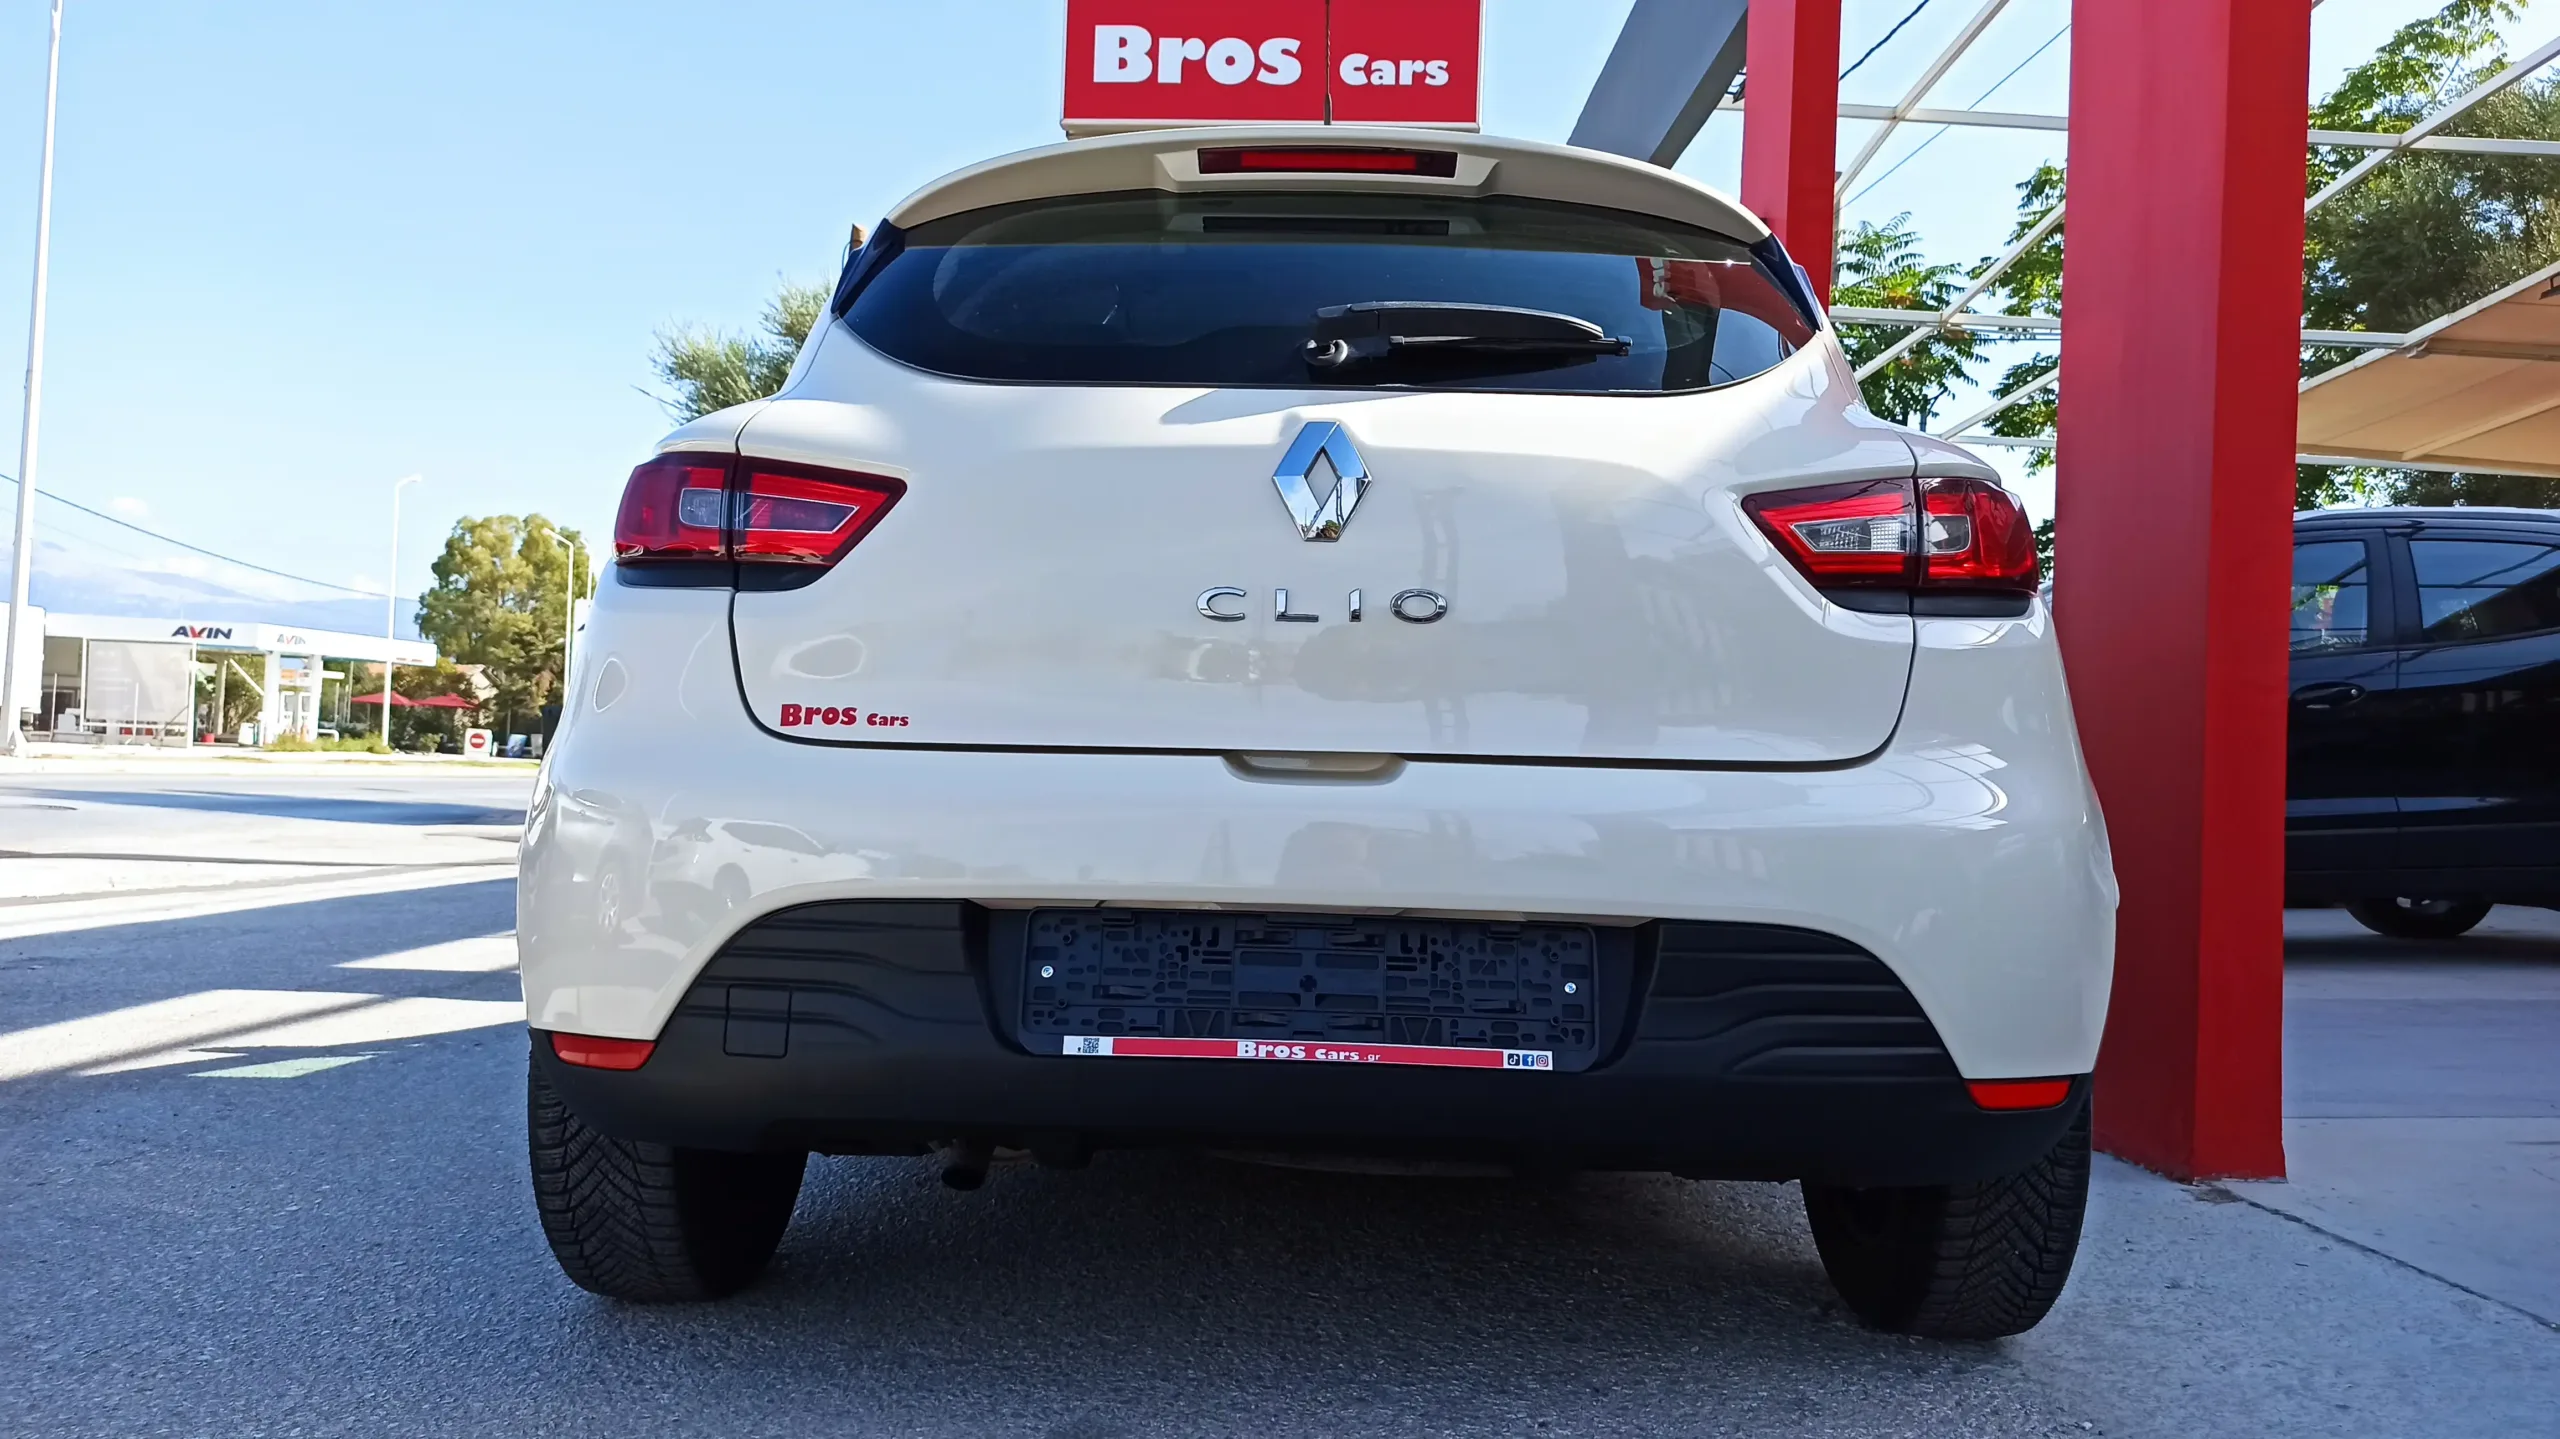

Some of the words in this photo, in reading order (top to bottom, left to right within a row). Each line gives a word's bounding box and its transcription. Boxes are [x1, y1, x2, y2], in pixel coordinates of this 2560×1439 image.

[1093, 24, 1302, 86] Bros
[1196, 586, 1448, 624] CLIO
[171, 625, 233, 640] AVIN
[780, 703, 858, 727] Bros
[1236, 1041, 1306, 1059] Bros
